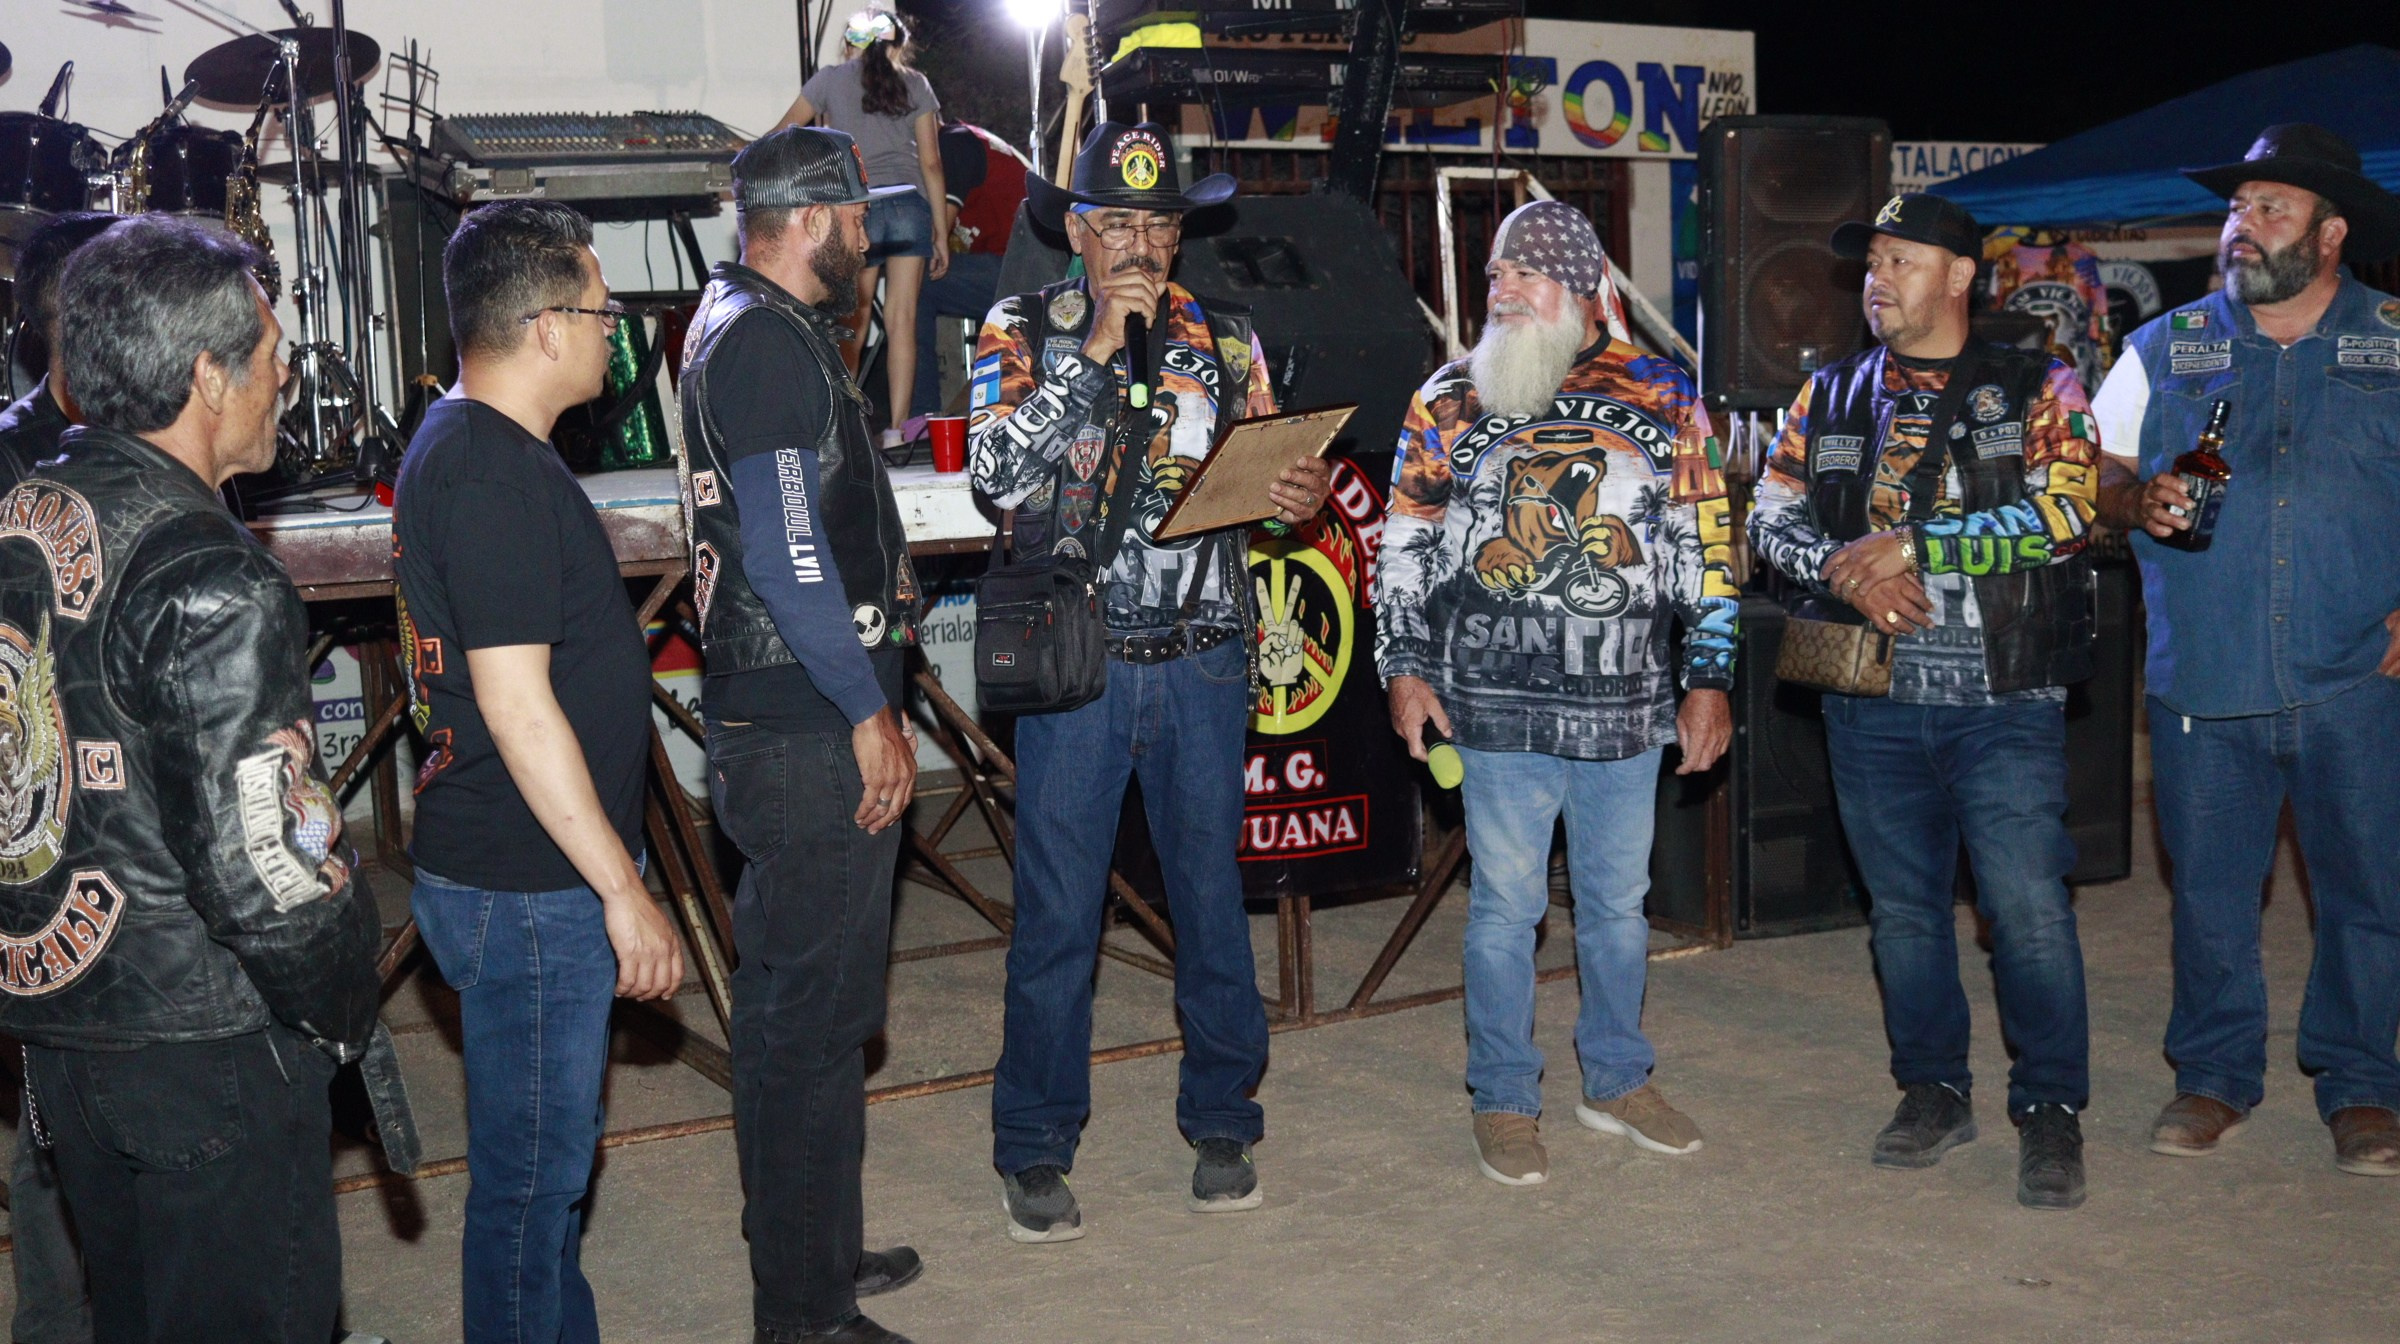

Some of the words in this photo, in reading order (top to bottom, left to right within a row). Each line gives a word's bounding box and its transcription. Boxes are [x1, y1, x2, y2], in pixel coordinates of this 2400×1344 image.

[1111, 131, 1140, 165] PEACE
[1142, 132, 1166, 168] RIDER
[2173, 343, 2227, 354] PERALTA
[1554, 400, 1673, 459] VIEJOS
[776, 448, 812, 543] ERBOWL
[789, 544, 824, 582] LVII
[1925, 535, 2050, 575] LUIS
[321, 701, 364, 720] con
[87, 750, 113, 783] C
[0, 890, 109, 987] ICALI
